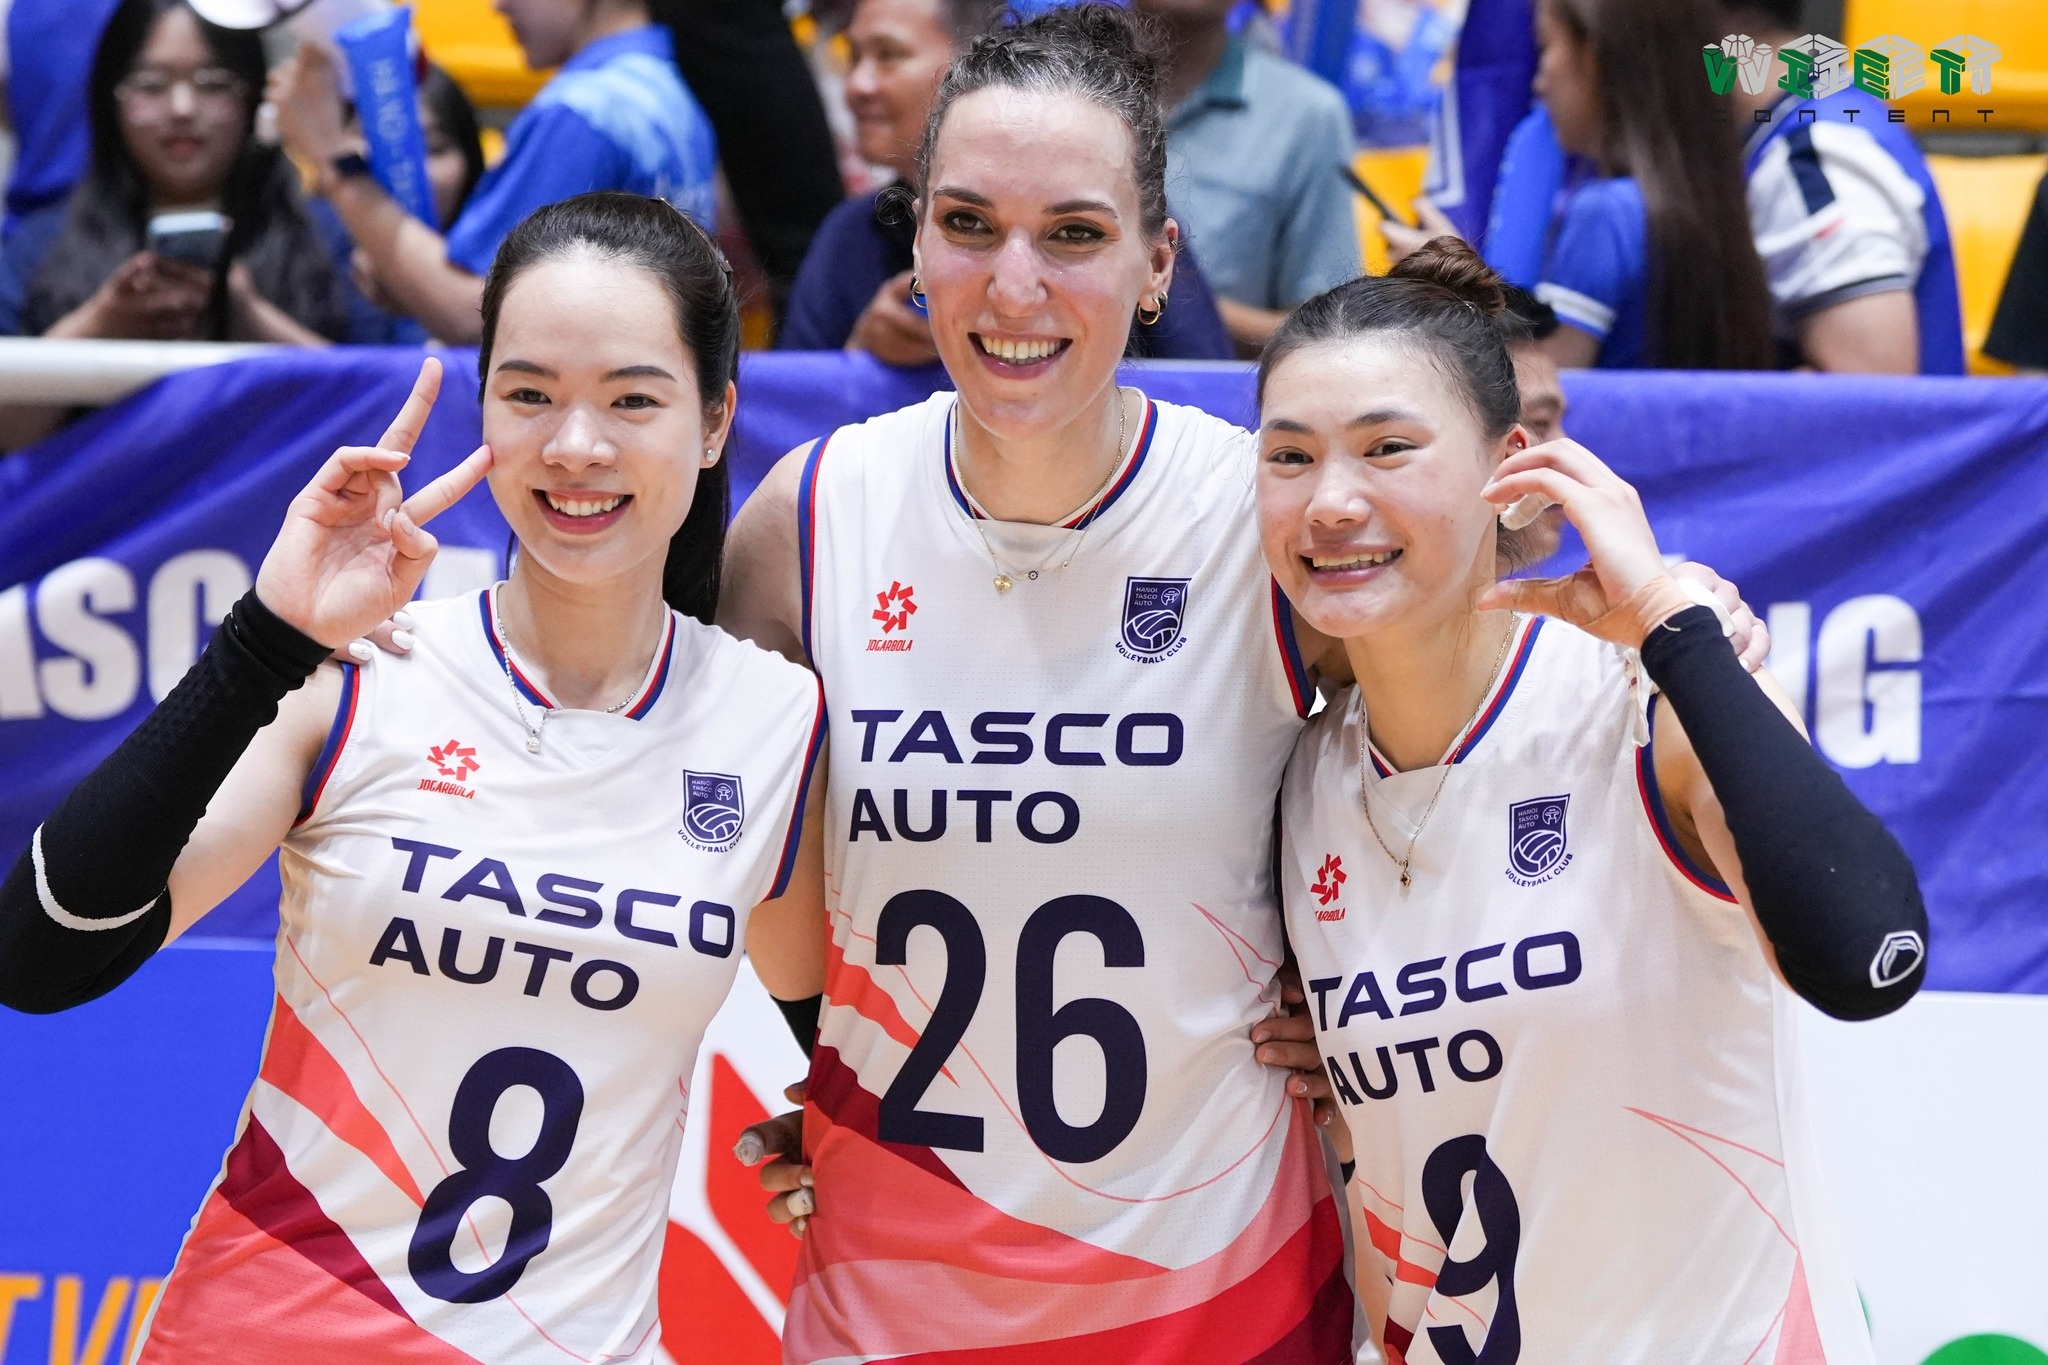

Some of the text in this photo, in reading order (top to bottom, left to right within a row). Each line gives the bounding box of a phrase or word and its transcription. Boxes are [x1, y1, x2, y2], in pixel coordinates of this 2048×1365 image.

[866, 639, 914, 652] JOGARBOLA
[1115, 636, 1187, 664] VOLLEYBALL CLUB
[850, 709, 1185, 767] TASCO
[417, 779, 475, 799] JOGARBOLA
[692, 791, 709, 799] AUTO
[849, 788, 1081, 845] AUTO
[1518, 808, 1538, 817] HANOI
[1518, 814, 1539, 823] TASCO
[1518, 821, 1535, 829] AUTO
[677, 829, 743, 853] VOLLEYBALL CLUB
[1505, 853, 1573, 888] VOLLEYBALL CLUB
[391, 836, 735, 959] TASCO
[369, 916, 639, 1011] AUTO
[1308, 931, 1582, 1031] TASCO
[875, 889, 1148, 1164] 26
[1327, 1029, 1503, 1106] AUTO
[407, 1046, 585, 1304] 8
[1421, 1134, 1522, 1365] 9
